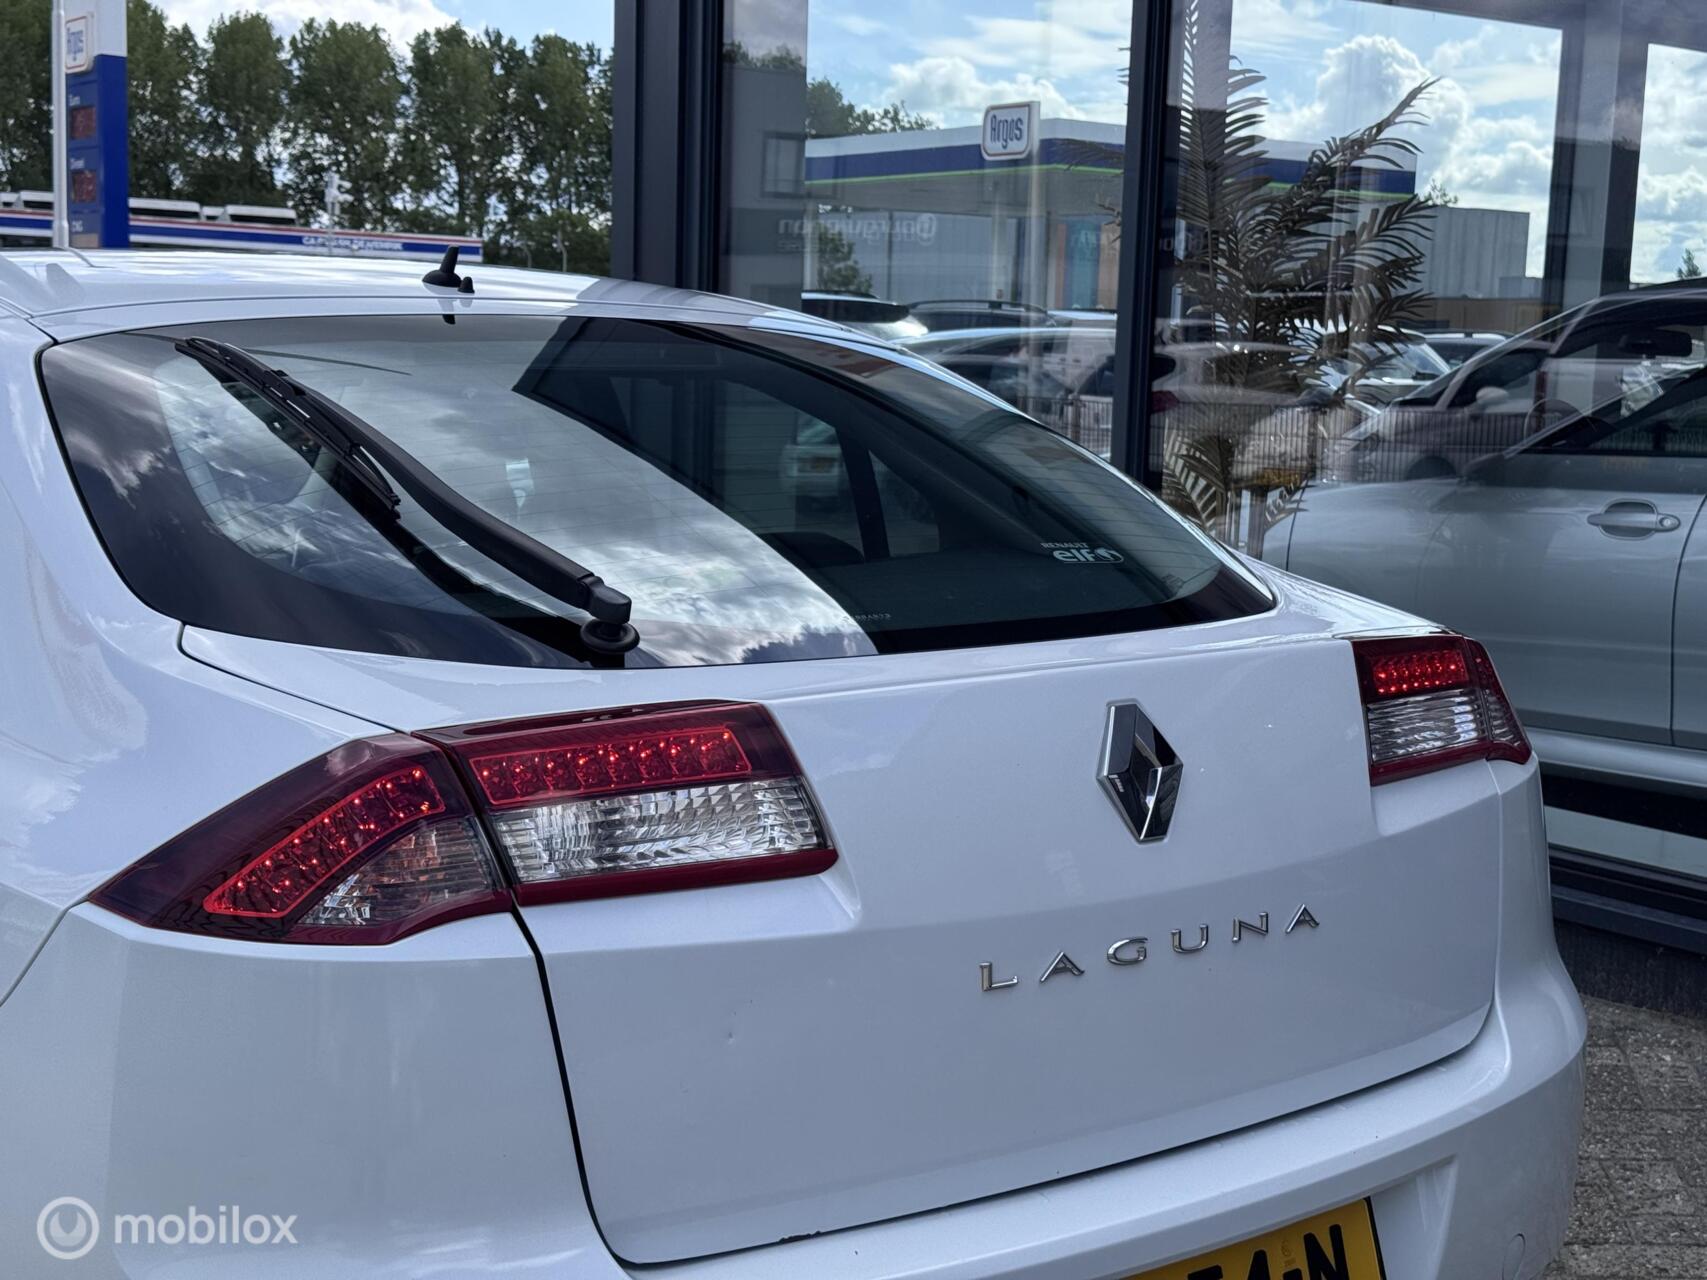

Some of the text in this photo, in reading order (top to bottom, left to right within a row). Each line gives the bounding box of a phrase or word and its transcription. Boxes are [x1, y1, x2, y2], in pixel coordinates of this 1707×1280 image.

[990, 114, 1024, 150] Argos
[1052, 548, 1097, 562] elf
[978, 903, 1320, 992] LAGUNA
